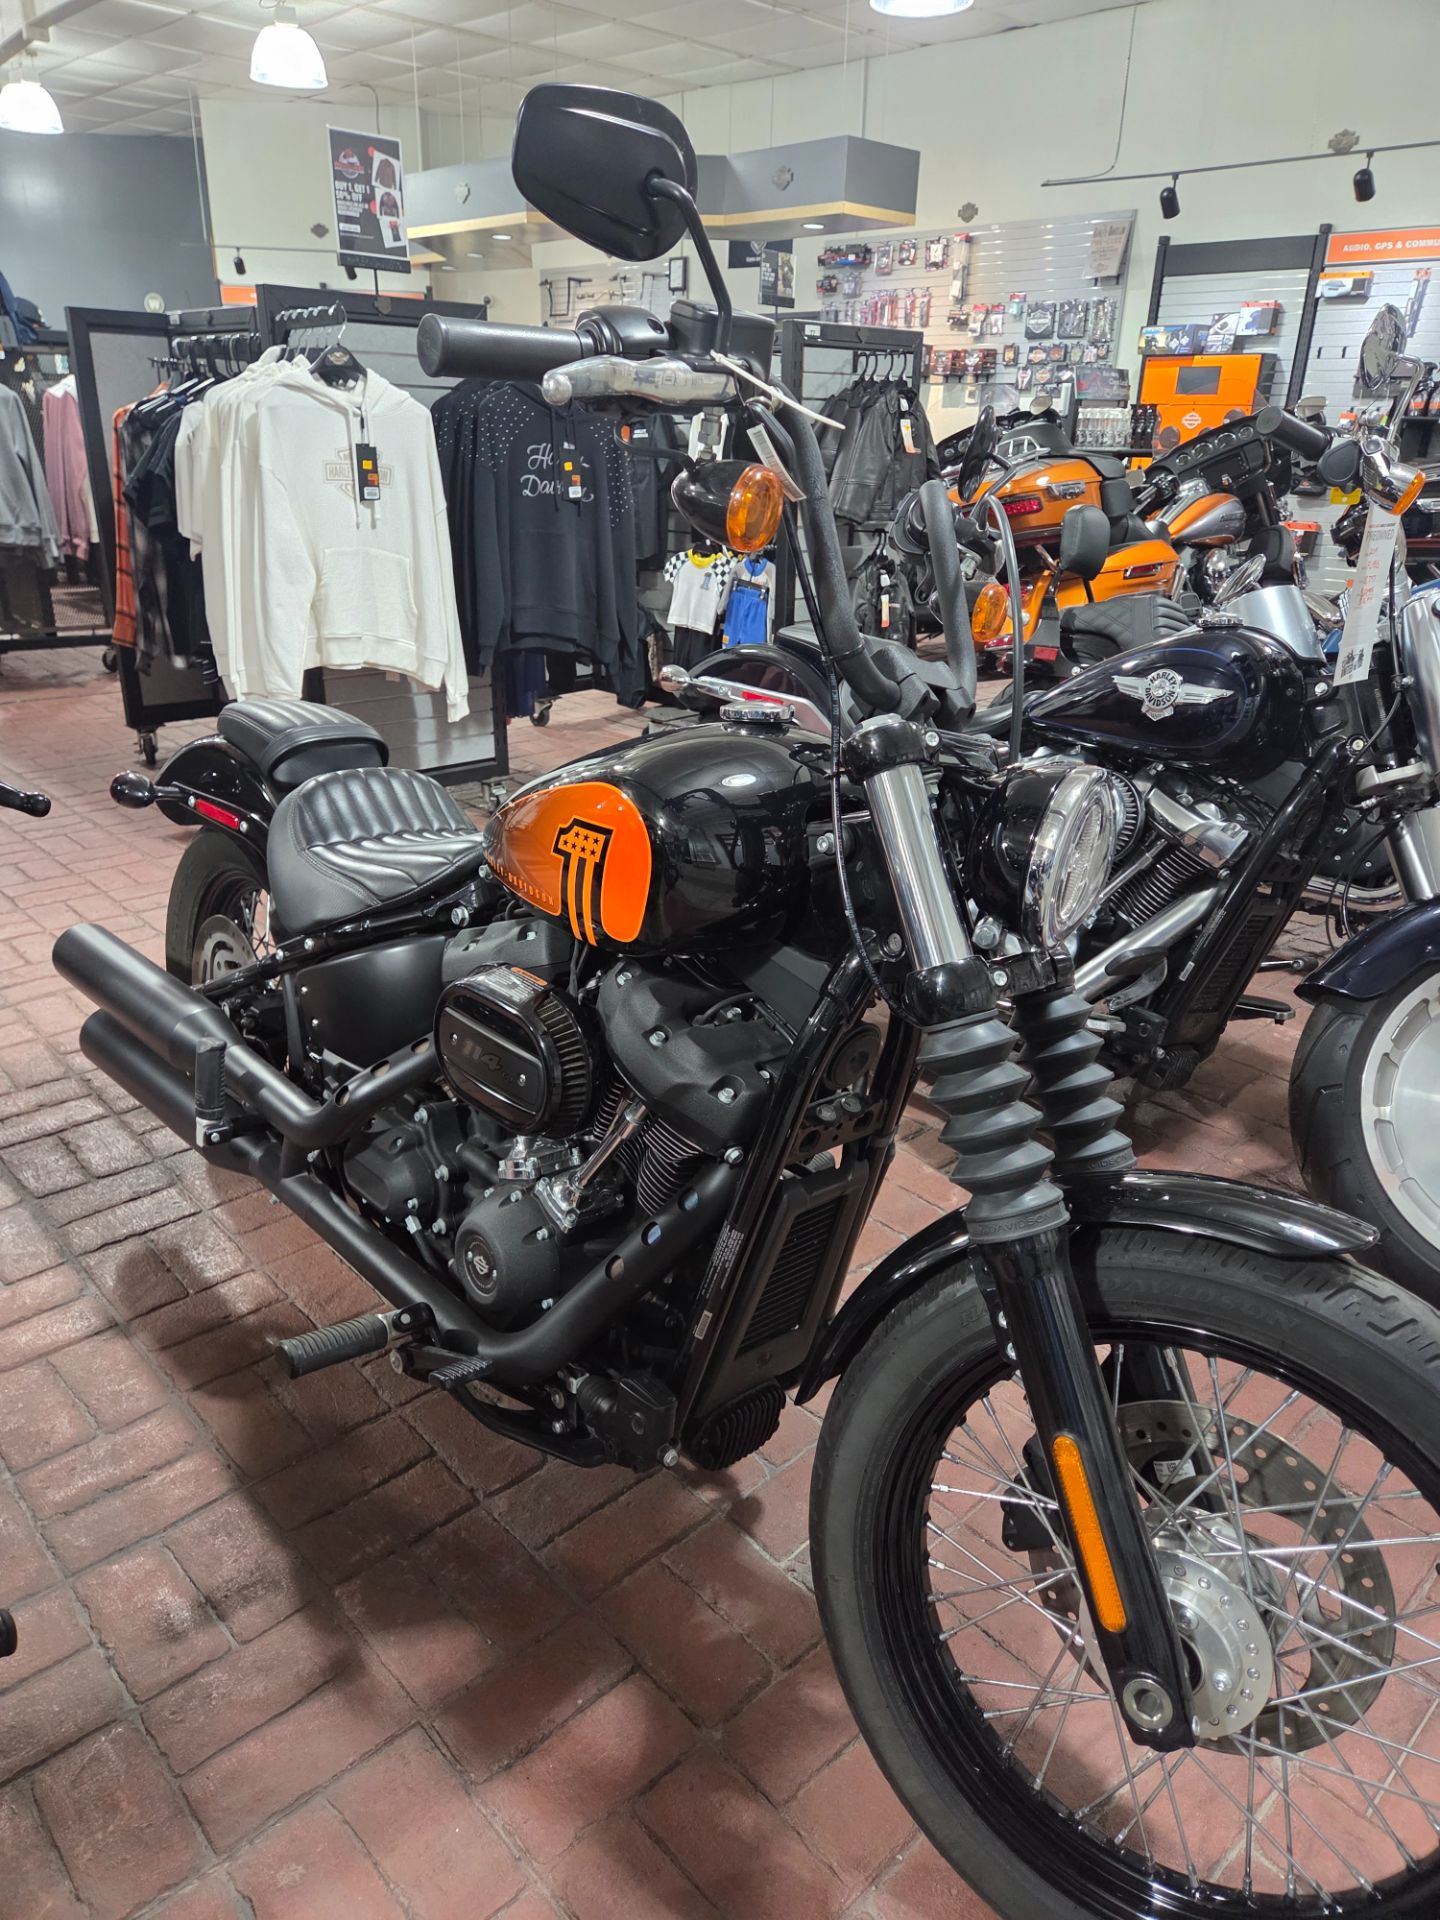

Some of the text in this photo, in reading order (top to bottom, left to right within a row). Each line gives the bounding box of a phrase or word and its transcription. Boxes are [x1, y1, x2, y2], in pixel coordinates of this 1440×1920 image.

[1374, 241, 1393, 251] GPS
[1395, 241, 1403, 249] &
[1150, 671, 1178, 686] HARLEY
[1144, 687, 1176, 707] DAVIDSON
